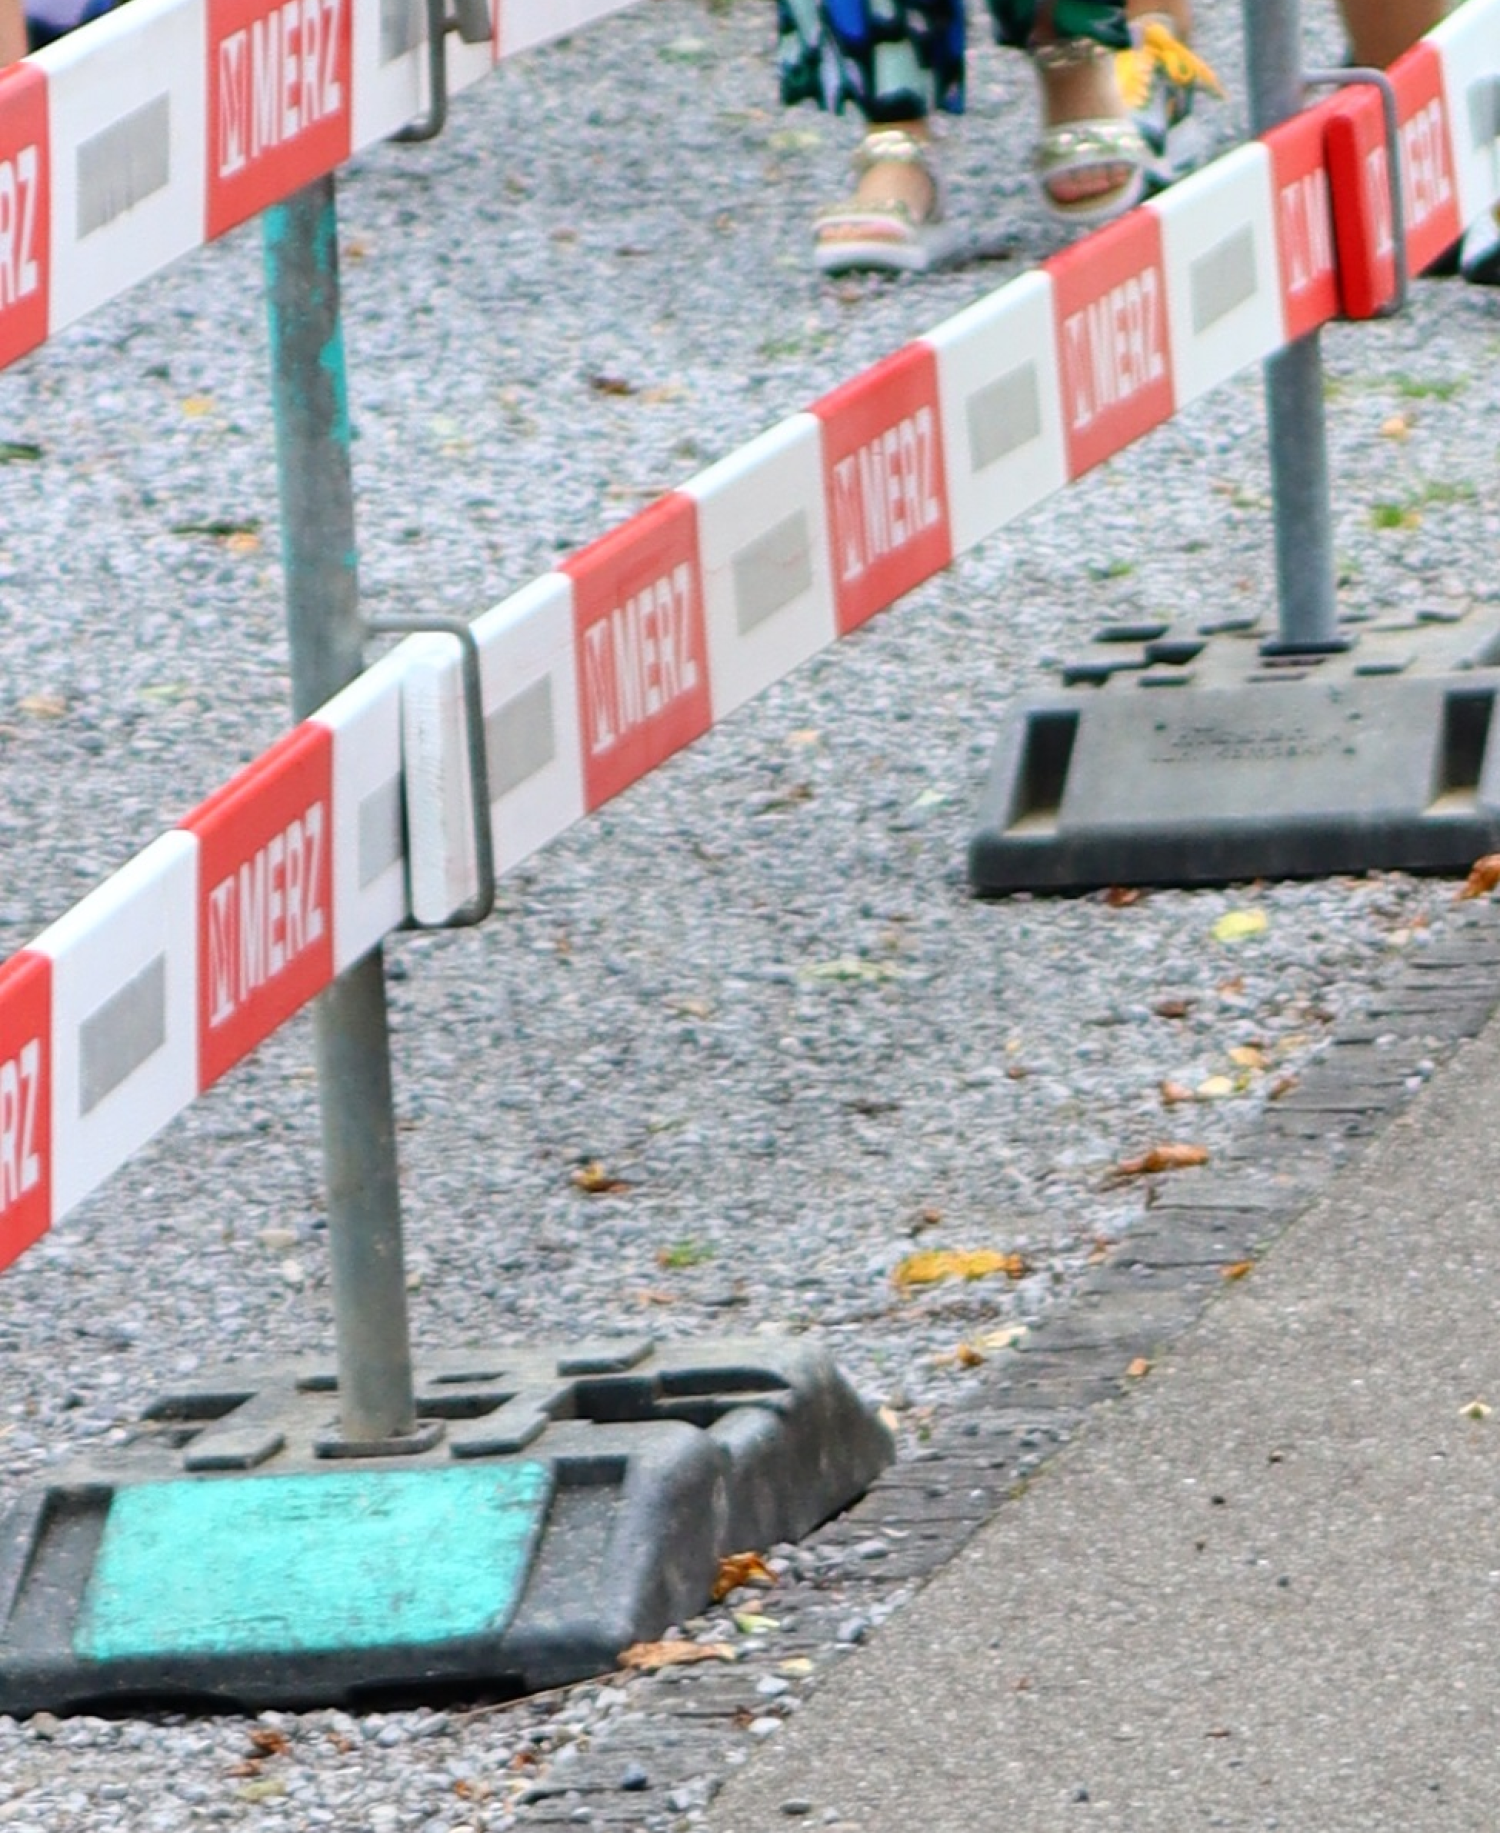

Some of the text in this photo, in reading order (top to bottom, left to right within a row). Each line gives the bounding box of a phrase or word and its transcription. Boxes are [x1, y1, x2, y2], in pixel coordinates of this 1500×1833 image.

[0, 143, 38, 309] RZ
[1088, 266, 1167, 415] MERZ
[859, 404, 940, 560] MERZ
[612, 563, 698, 728] MERZ
[239, 801, 324, 1002] MERZ
[0, 1037, 39, 1212] RZ
